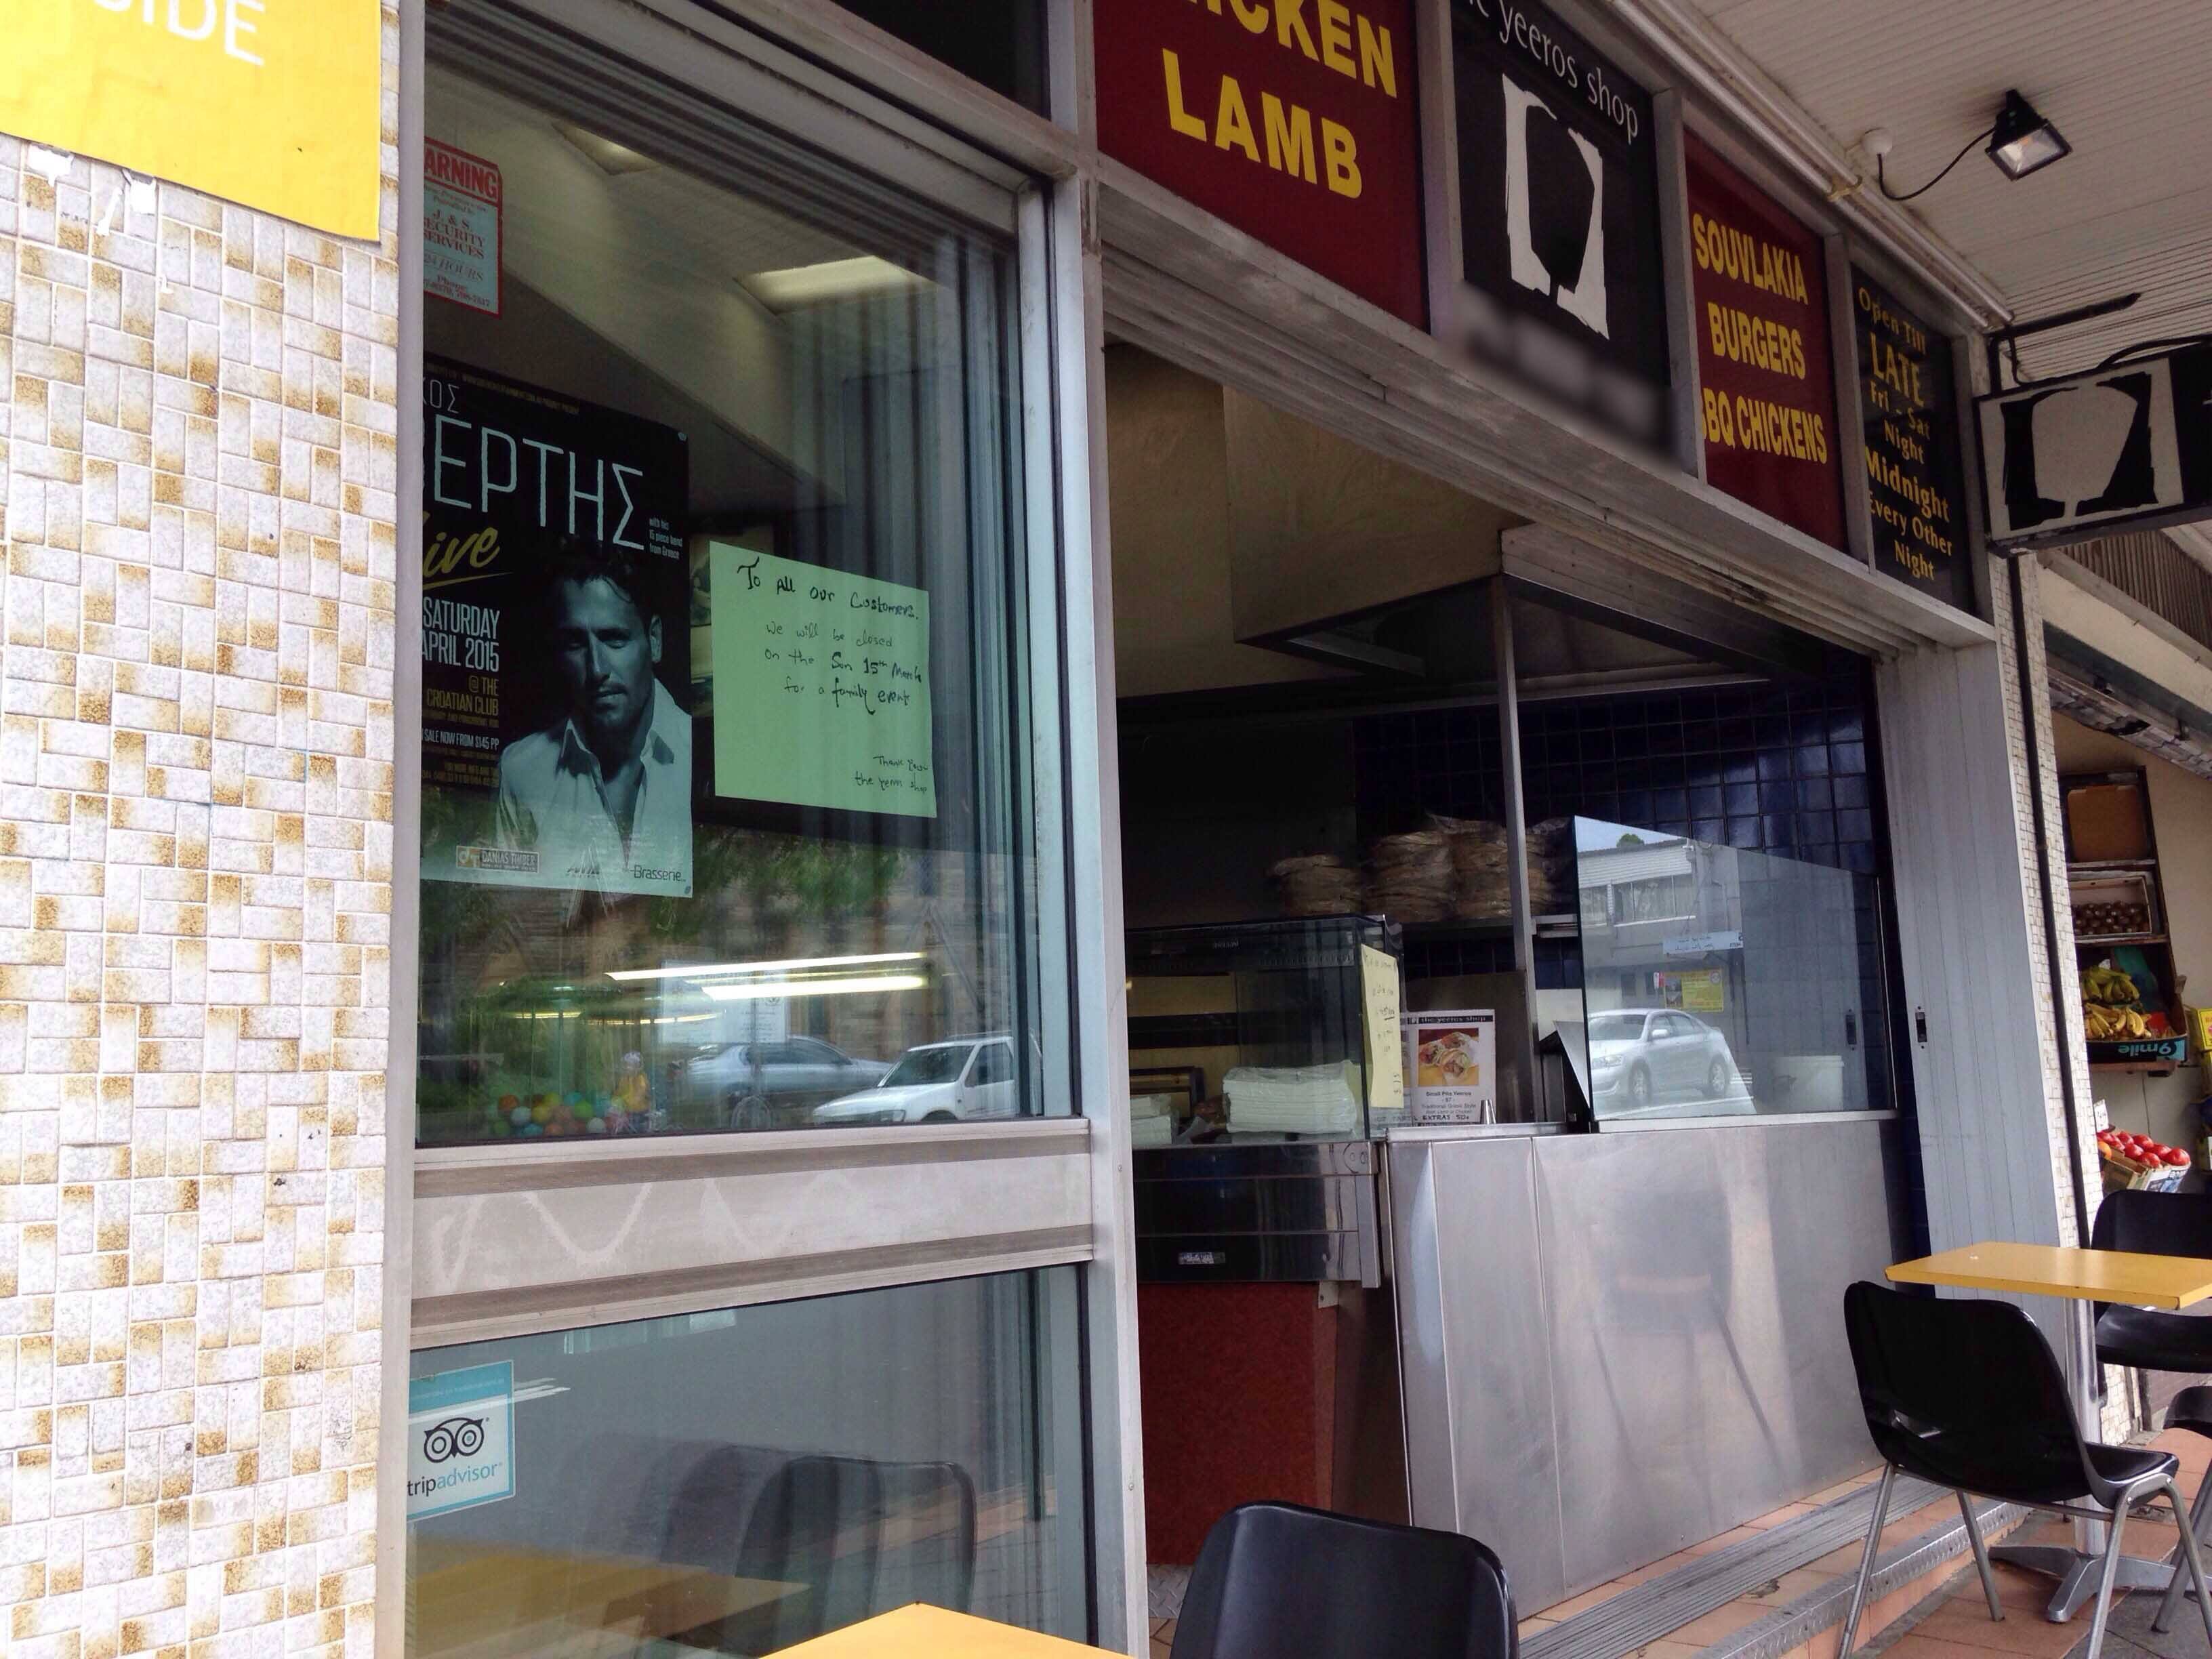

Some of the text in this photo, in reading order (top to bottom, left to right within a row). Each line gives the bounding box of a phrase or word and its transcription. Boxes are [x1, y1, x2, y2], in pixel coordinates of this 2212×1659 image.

[1499, 0, 1638, 145] yeeros shop
[1162, 47, 1362, 199] LAMB
[1693, 213, 1809, 305] SOUVLAKIA
[1859, 287, 1900, 335] Open
[1707, 302, 1806, 380] BURGERS
[1870, 331, 1925, 407] LATE
[1736, 395, 1828, 465] CHICKENS
[1870, 380, 1889, 413] Fri
[1907, 406, 1930, 439] Sat
[1884, 418, 1925, 464] Night
[423, 413, 644, 550] ΕΡΤΗΣ
[1865, 445, 1950, 523] Midnight
[423, 515, 501, 577] ive
[1869, 489, 1952, 557] Every Other
[737, 556, 761, 590] To
[777, 575, 796, 594] All
[1894, 540, 1935, 581] Night
[423, 596, 500, 639] SATURDAY
[796, 622, 819, 638] will
[833, 628, 846, 641] be
[855, 632, 893, 647] closed
[422, 630, 499, 672] APRIL 2015
[788, 649, 815, 666] the
[427, 688, 499, 716] CROATIAN CLUB
[482, 677, 499, 696] THE
[784, 676, 805, 693] for
[832, 677, 876, 715] family
[424, 729, 439, 743] SALE
[440, 731, 455, 745] NOW
[456, 733, 474, 747] FROM
[855, 770, 874, 786] the
[407, 1463, 498, 1497] tripadvisor
